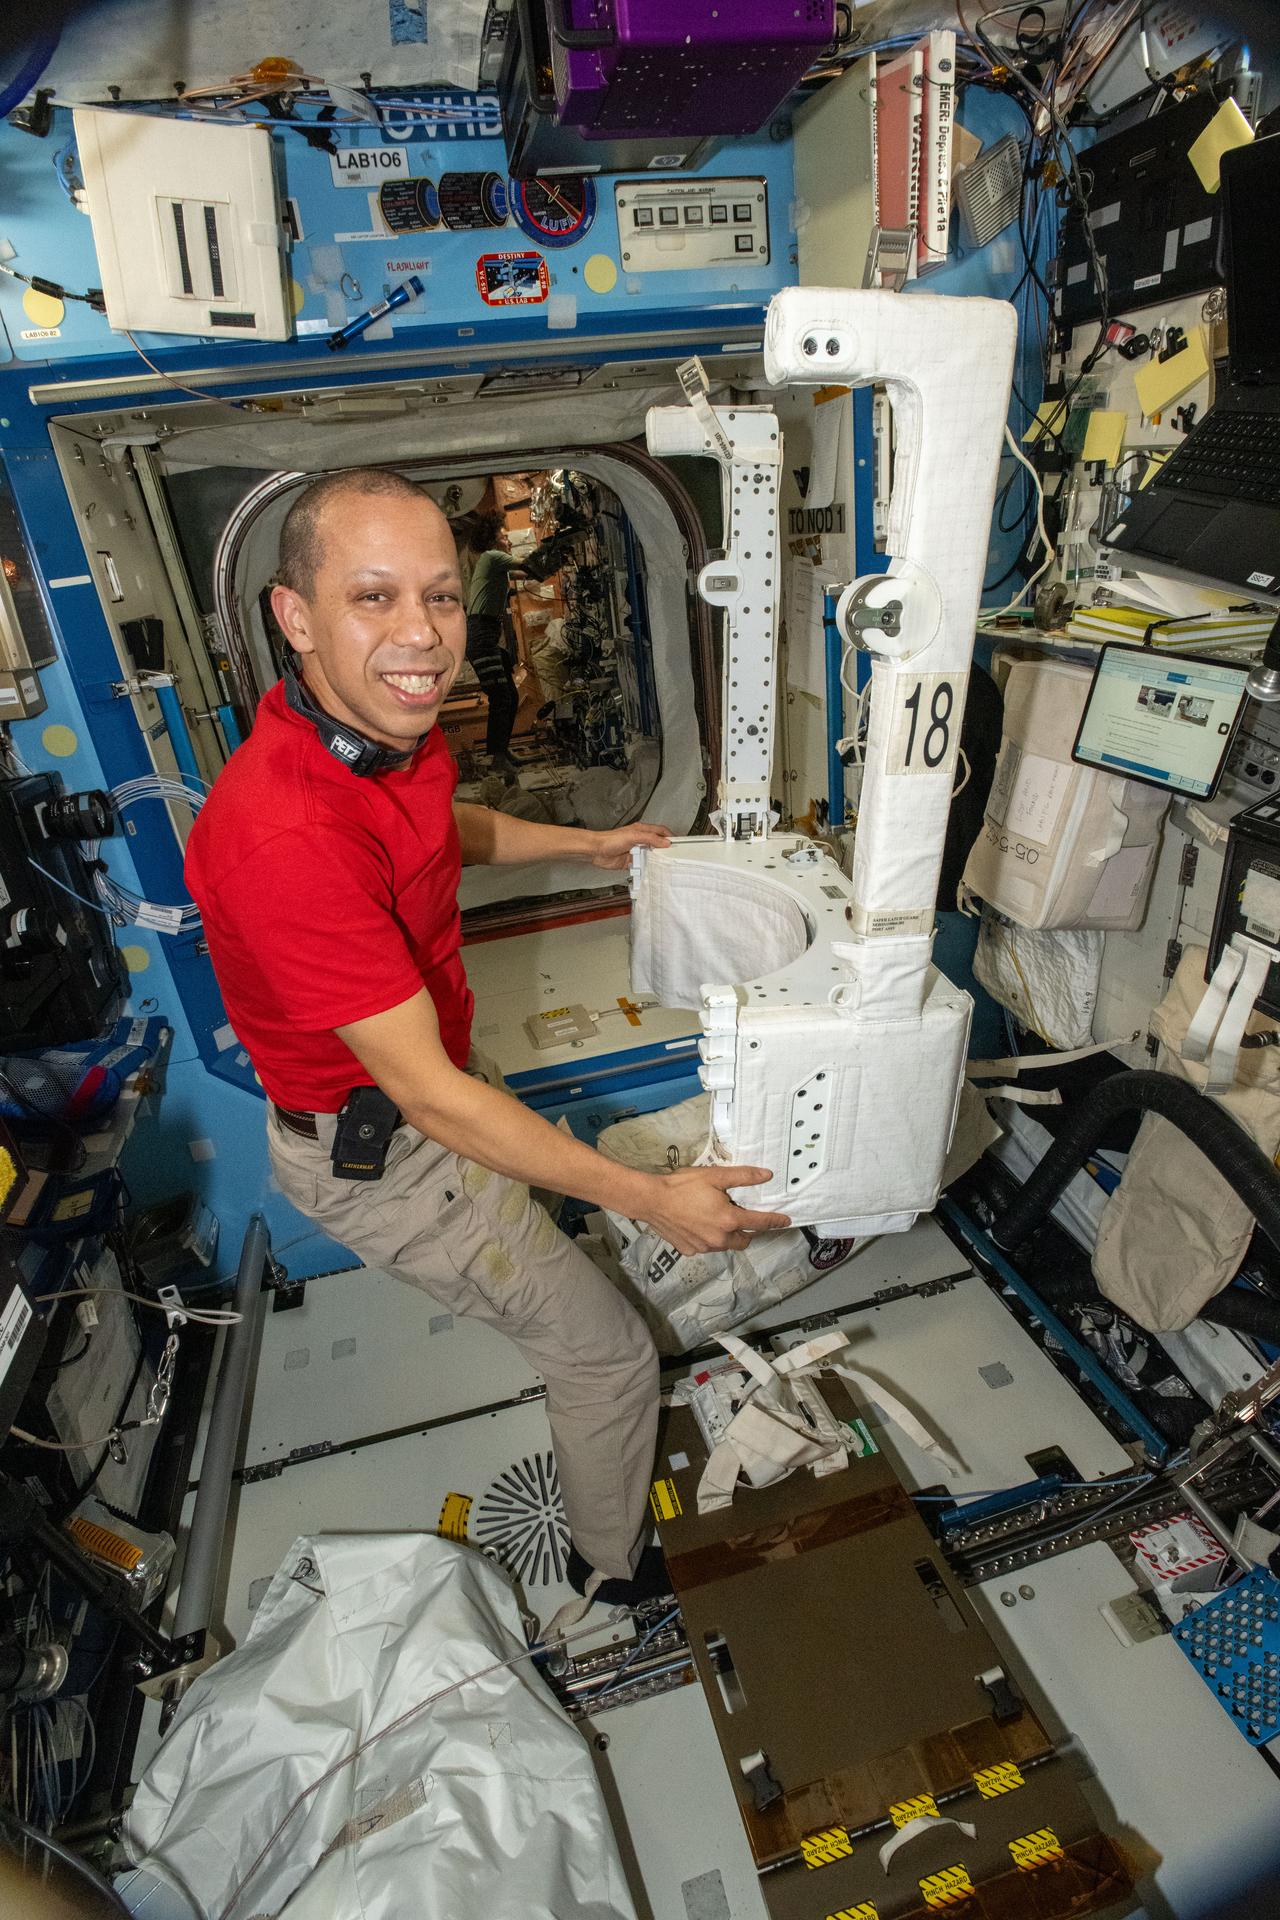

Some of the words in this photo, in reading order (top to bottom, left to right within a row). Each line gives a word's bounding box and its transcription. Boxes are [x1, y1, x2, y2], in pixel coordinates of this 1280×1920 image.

[939, 83, 951, 122] EMER:
[382, 95, 503, 140] OVHD
[936, 125, 949, 174] Depress
[541, 215, 578, 231] LUFA
[936, 217, 948, 232] 1a
[386, 261, 430, 272] FLASHLIGHT
[789, 509, 804, 534] TO
[807, 507, 833, 534] NOD
[837, 505, 843, 532] 1
[905, 682, 953, 767] 18
[330, 735, 362, 760] PETZ
[342, 1161, 375, 1170] LEATHERMAN
[980, 1775, 1001, 1788] HAZARD
[1002, 1770, 1020, 1782] PINCH
[895, 1807, 917, 1822] HAZARD
[917, 1802, 936, 1814] PINCH
[806, 1842, 829, 1857] HAZARD
[830, 1837, 848, 1849] PINCH
[1015, 1847, 1033, 1860] PINCH
[1033, 1839, 1057, 1854] HAZARD
[925, 1885, 943, 1899] PINCH
[944, 1875, 968, 1892] HAZARD
